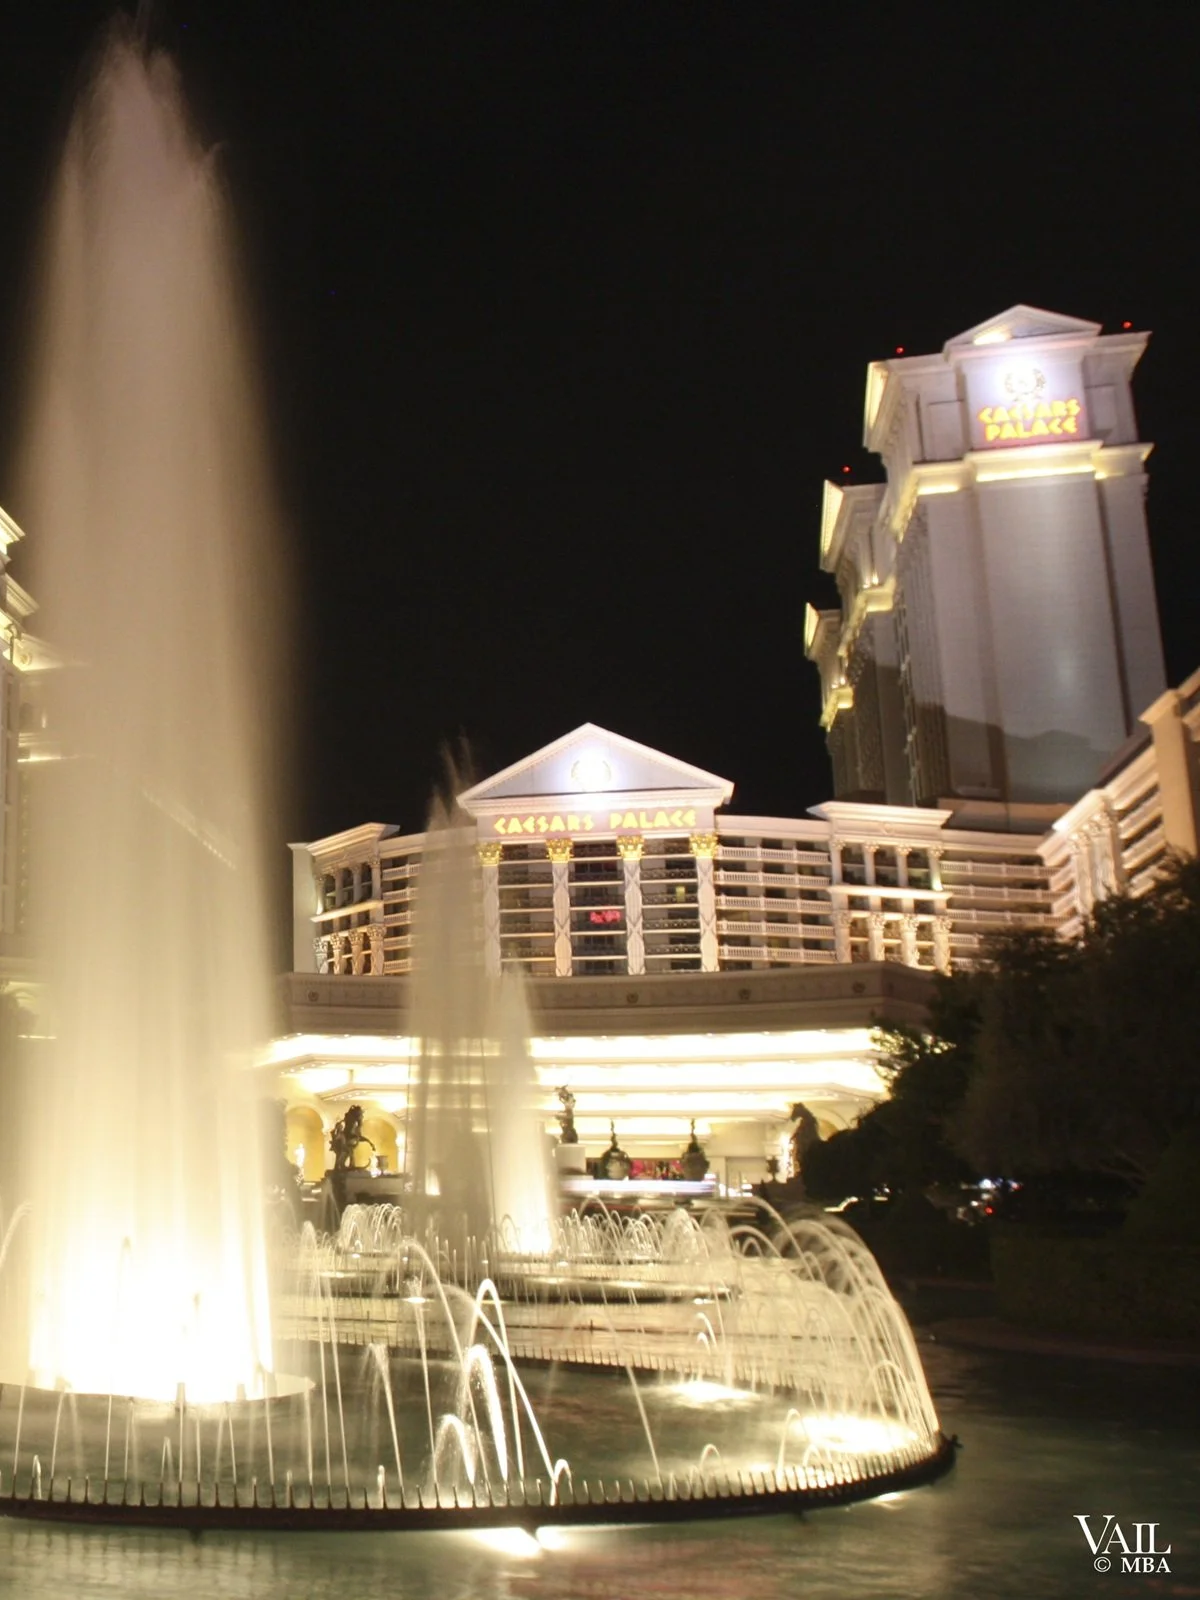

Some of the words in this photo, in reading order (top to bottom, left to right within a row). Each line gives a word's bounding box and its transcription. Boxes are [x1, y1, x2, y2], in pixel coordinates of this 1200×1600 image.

[985, 415, 1078, 442] PALACE
[493, 814, 595, 835] CAESARS
[609, 808, 697, 830] PALACE
